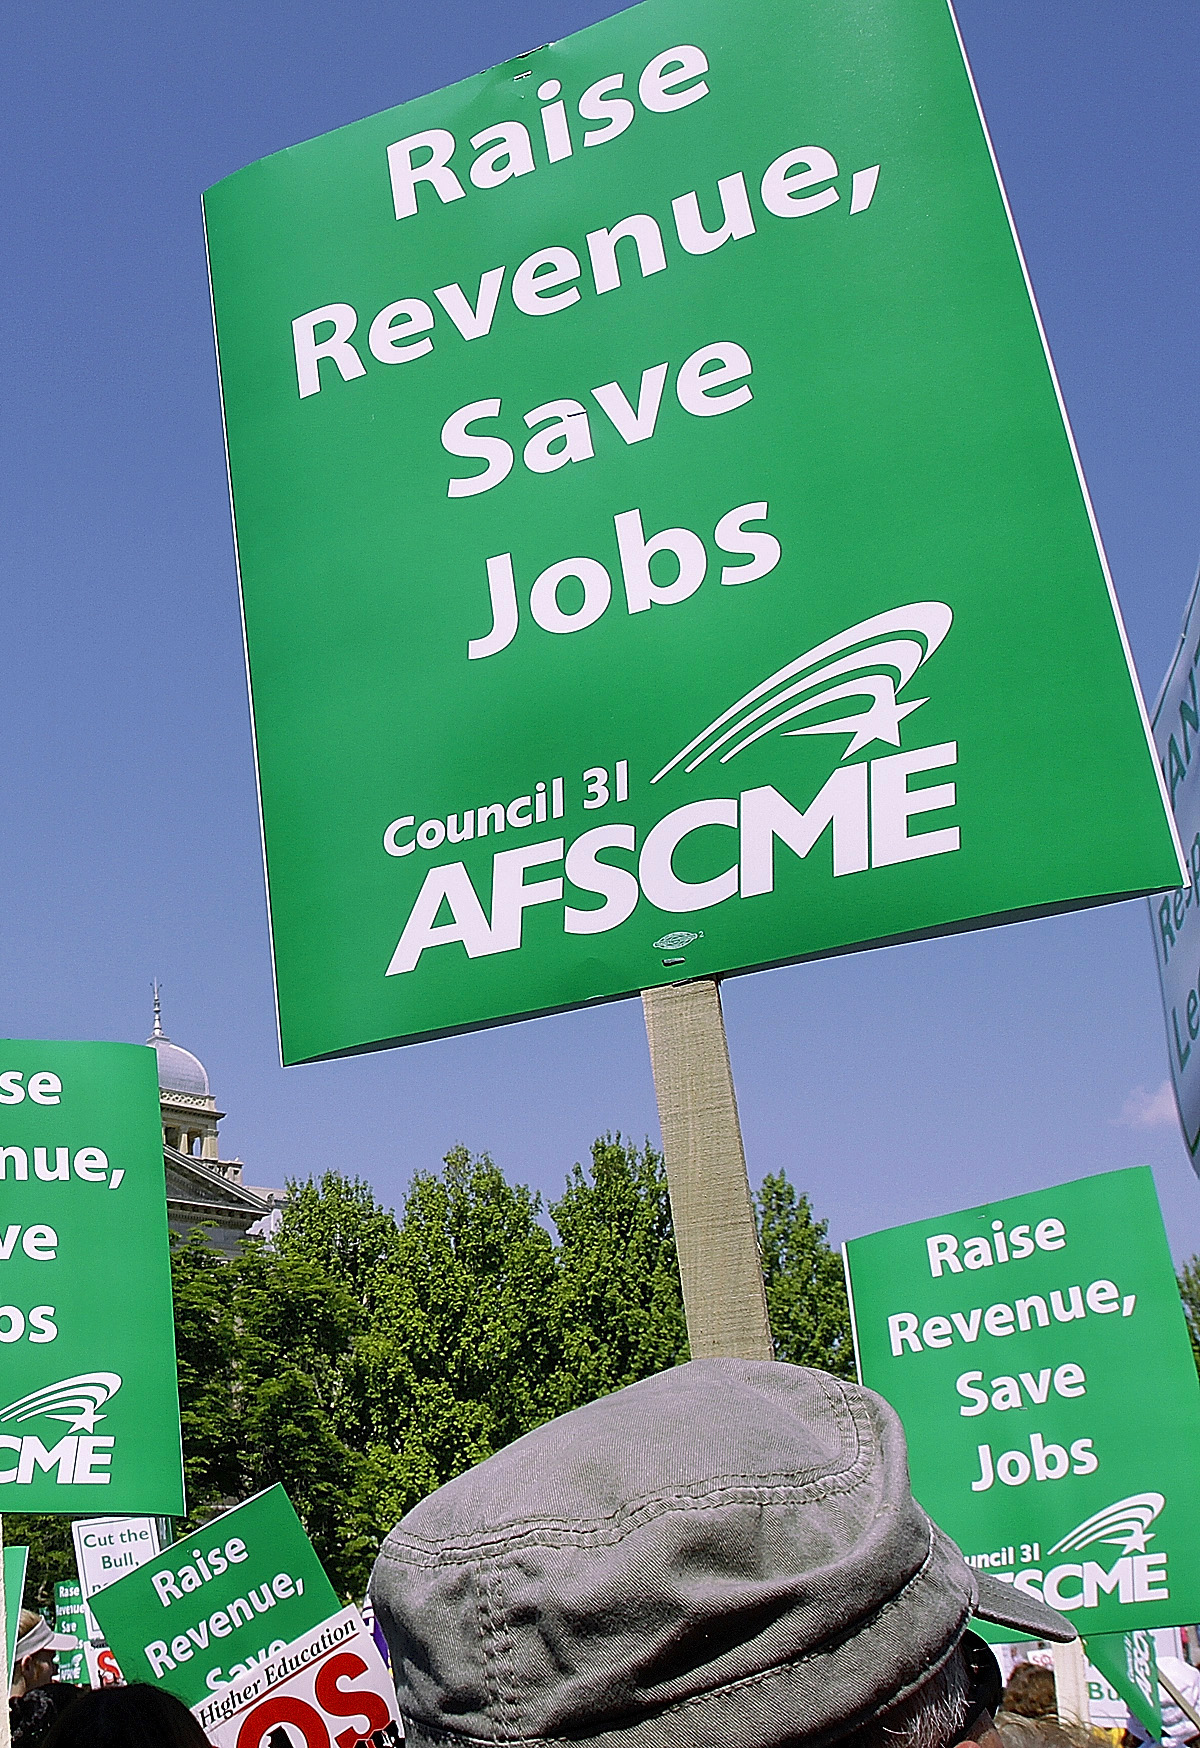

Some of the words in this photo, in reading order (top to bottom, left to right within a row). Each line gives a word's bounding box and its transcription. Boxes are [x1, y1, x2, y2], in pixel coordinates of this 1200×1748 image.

[386, 44, 710, 221] Raise
[291, 143, 881, 399] Revenue,
[441, 341, 753, 498] Save
[468, 501, 781, 660] Jobs
[384, 777, 566, 857] Council
[583, 759, 628, 810] 31
[386, 742, 959, 975] AFSCME
[926, 1218, 1066, 1278] Raise
[887, 1279, 1136, 1357] Revenue,
[956, 1363, 1086, 1417] Save
[971, 1432, 1099, 1492] Jobs
[83, 1533, 115, 1547] Cut
[119, 1529, 150, 1543] the
[101, 1552, 140, 1570] Bull,
[151, 1534, 249, 1608] Raise
[964, 1546, 1015, 1568] uncil
[1020, 1542, 1040, 1563] 31
[990, 1552, 1169, 1612] SCME
[144, 1569, 305, 1680] Revenue,
[198, 1678, 261, 1729] Higher
[264, 1619, 357, 1687] Education
